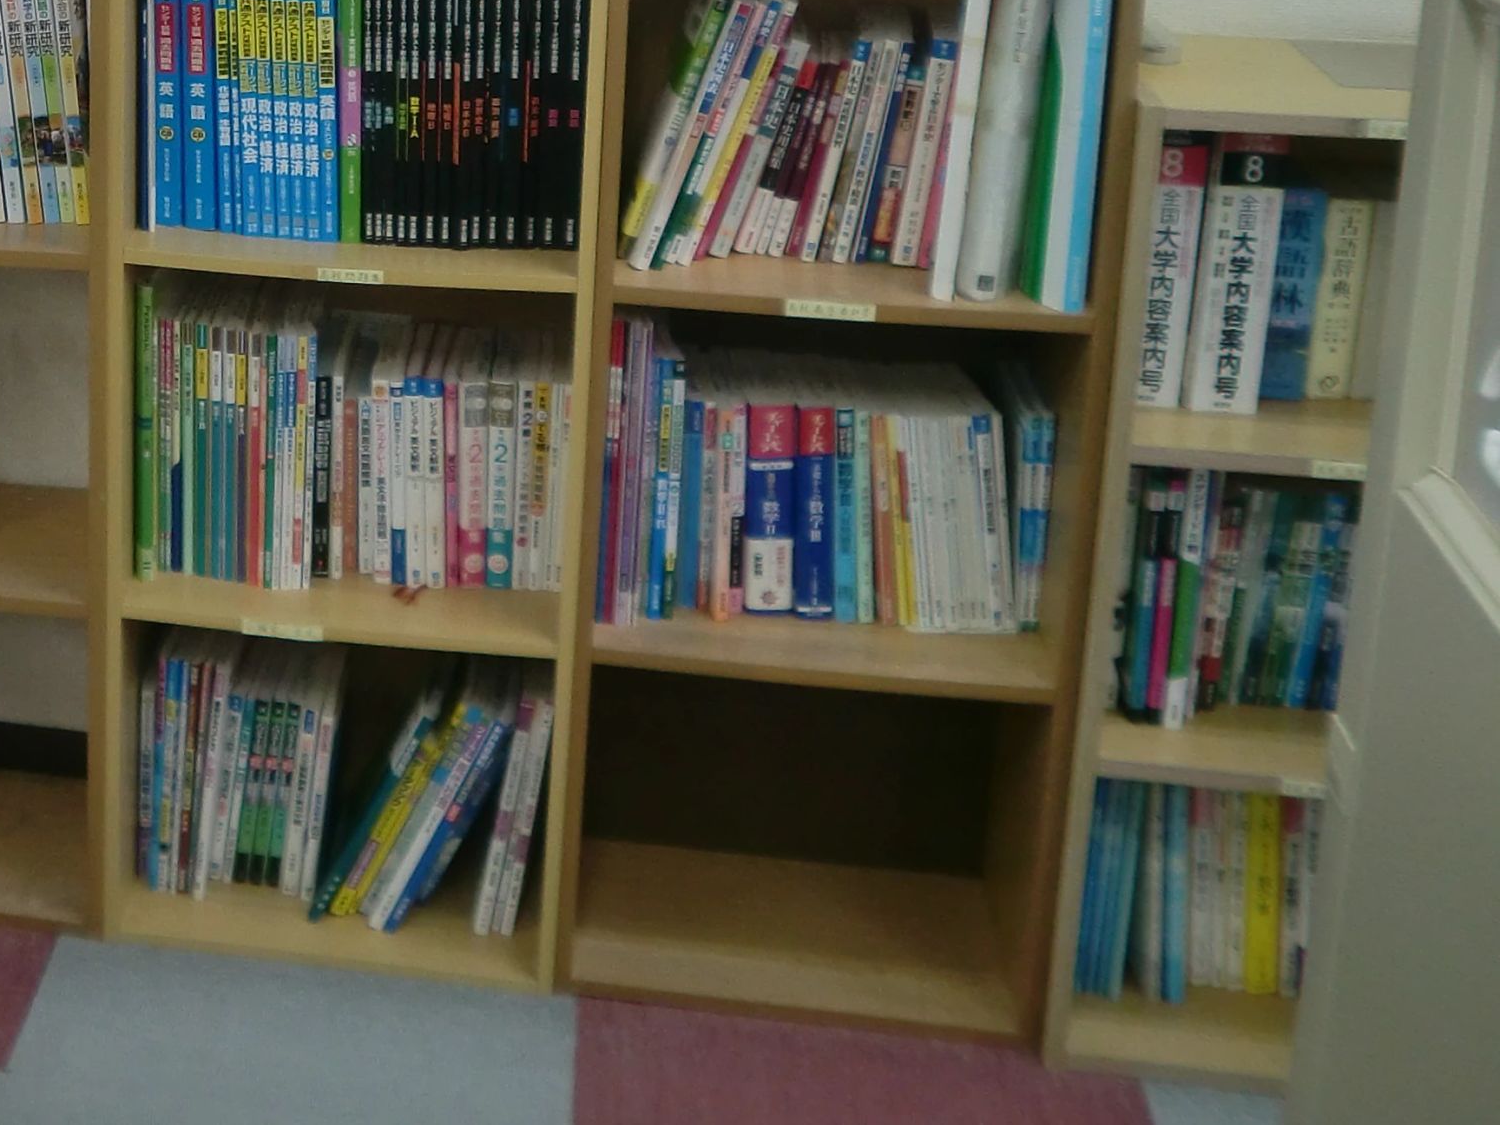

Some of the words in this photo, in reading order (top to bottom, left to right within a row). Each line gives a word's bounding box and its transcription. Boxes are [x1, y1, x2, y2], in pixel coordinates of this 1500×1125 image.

[158, 82, 174, 119] 英語
[190, 83, 206, 120] 英語
[241, 97, 258, 164] 現代社会
[763, 85, 790, 130] 日本史
[258, 99, 274, 174] 政治・経済
[274, 101, 289, 175] 政治・経済
[289, 101, 303, 176] 政治・経済
[304, 103, 319, 178] 政治・経済
[1161, 149, 1185, 178] 8
[1245, 155, 1264, 183] 8
[1139, 189, 1183, 394] 全国大学内容案内号
[1213, 194, 1260, 400] 全国大学内容案内号
